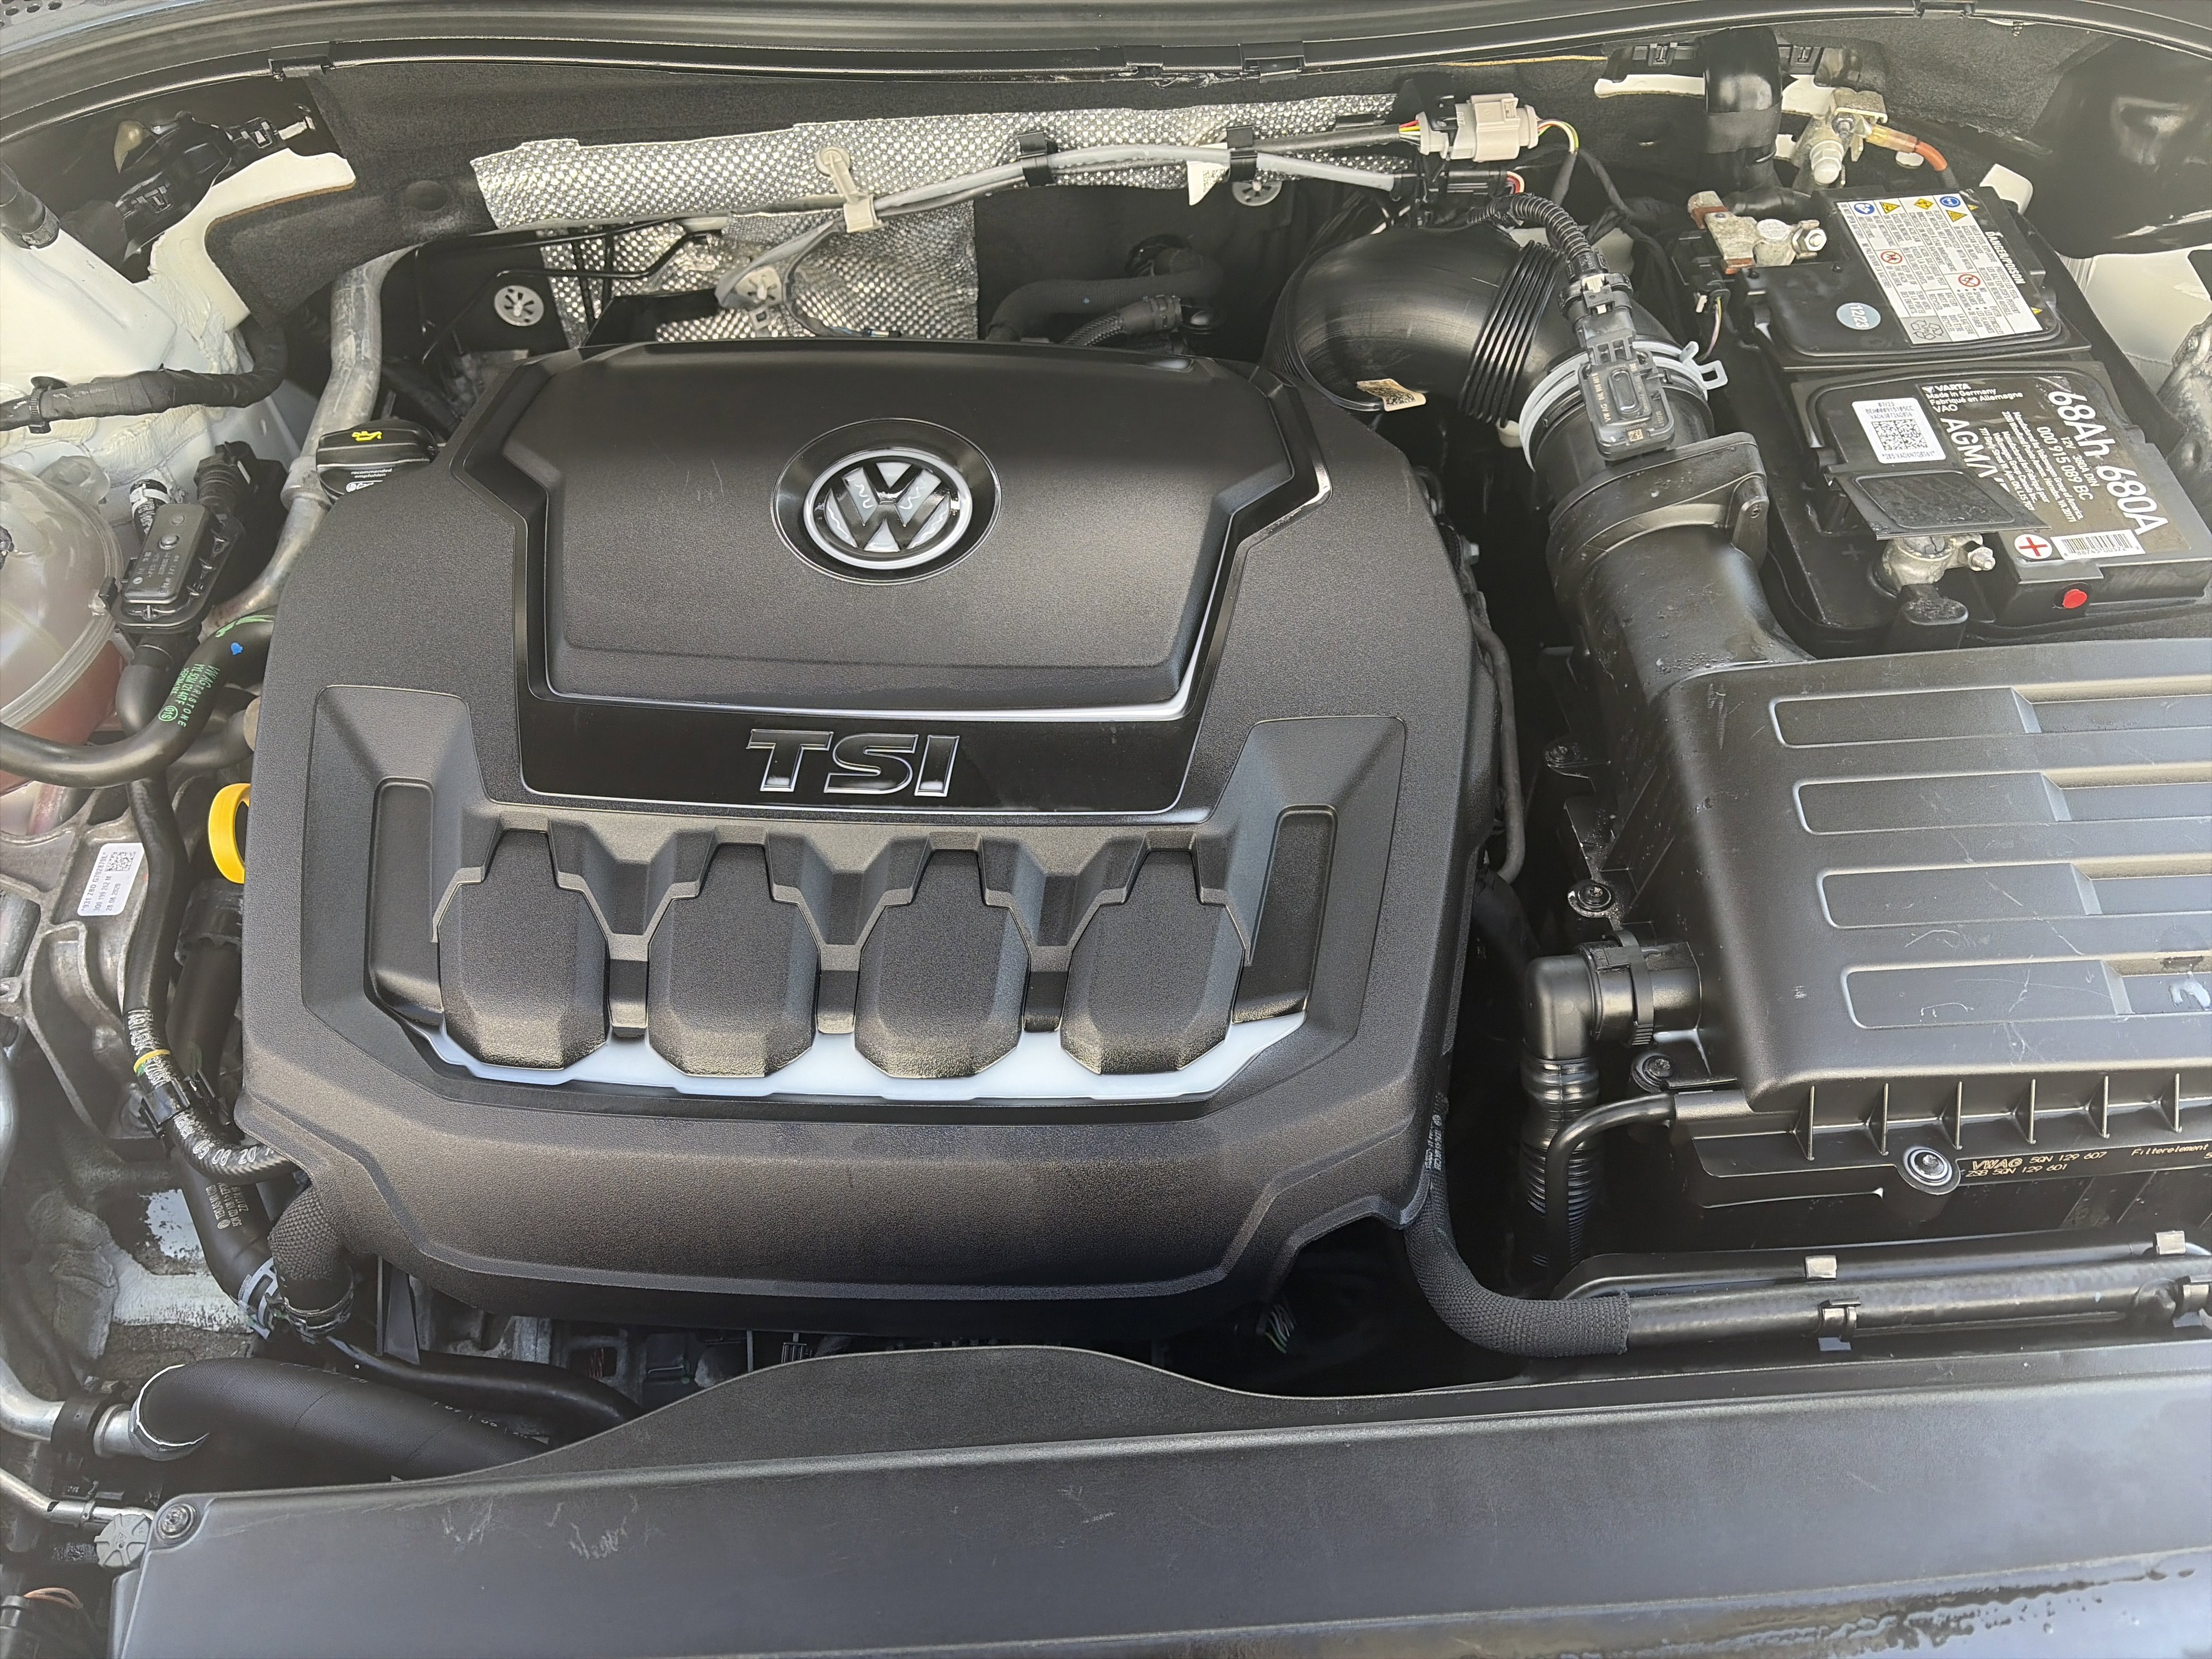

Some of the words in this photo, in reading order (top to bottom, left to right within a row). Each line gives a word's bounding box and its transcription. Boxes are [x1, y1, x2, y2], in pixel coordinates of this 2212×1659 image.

[1984, 230, 2026, 284] DANGER/POISON
[1850, 304, 1869, 328] 12/23
[1929, 396, 1966, 406] Fabriqué
[1980, 392, 2023, 402] Allemagne
[1933, 404, 1958, 413] VAO
[1960, 388, 1996, 397] Germany
[1978, 426, 1990, 437] 777
[1990, 448, 2006, 463] Street
[2002, 470, 2017, 481] Ajax
[1990, 432, 2015, 461] Volkswagen
[2006, 460, 2024, 475] Group
[2017, 475, 2035, 493] Canada
[2000, 430, 2027, 462] Manufactured
[2035, 491, 2051, 503] pour
[2001, 410, 2015, 422] 2200
[2008, 421, 2029, 445] Woodland
[2022, 444, 2038, 459] Pointe
[2061, 508, 2078, 522] 20171
[2012, 410, 2038, 443] Manufactured
[2034, 449, 2060, 477] Volkswagen
[2051, 477, 2069, 492] Group
[2035, 425, 2059, 444] 000
[2047, 445, 2071, 464] 915
[2059, 465, 2084, 483] 089
[2072, 485, 2095, 500] BC
[2048, 391, 2115, 457] 68Ah
[2096, 466, 2169, 535] 680A
[2059, 436, 2076, 450] 12V
[2071, 454, 2091, 472] 380A
[2083, 473, 2101, 487] DIN
[808, 452, 968, 564] VW
[178, 685, 204, 727] TRISTONE
[746, 728, 959, 797] TSI
[87, 884, 97, 896] ZBD
[211, 1148, 232, 1166] 08
[238, 1146, 257, 1165] 20
[1972, 1158, 2023, 1170] VWAG
[2029, 1155, 2053, 1164] 5QN
[2084, 1152, 2107, 1160] 607
[2131, 1144, 2209, 1156] Filterelement
